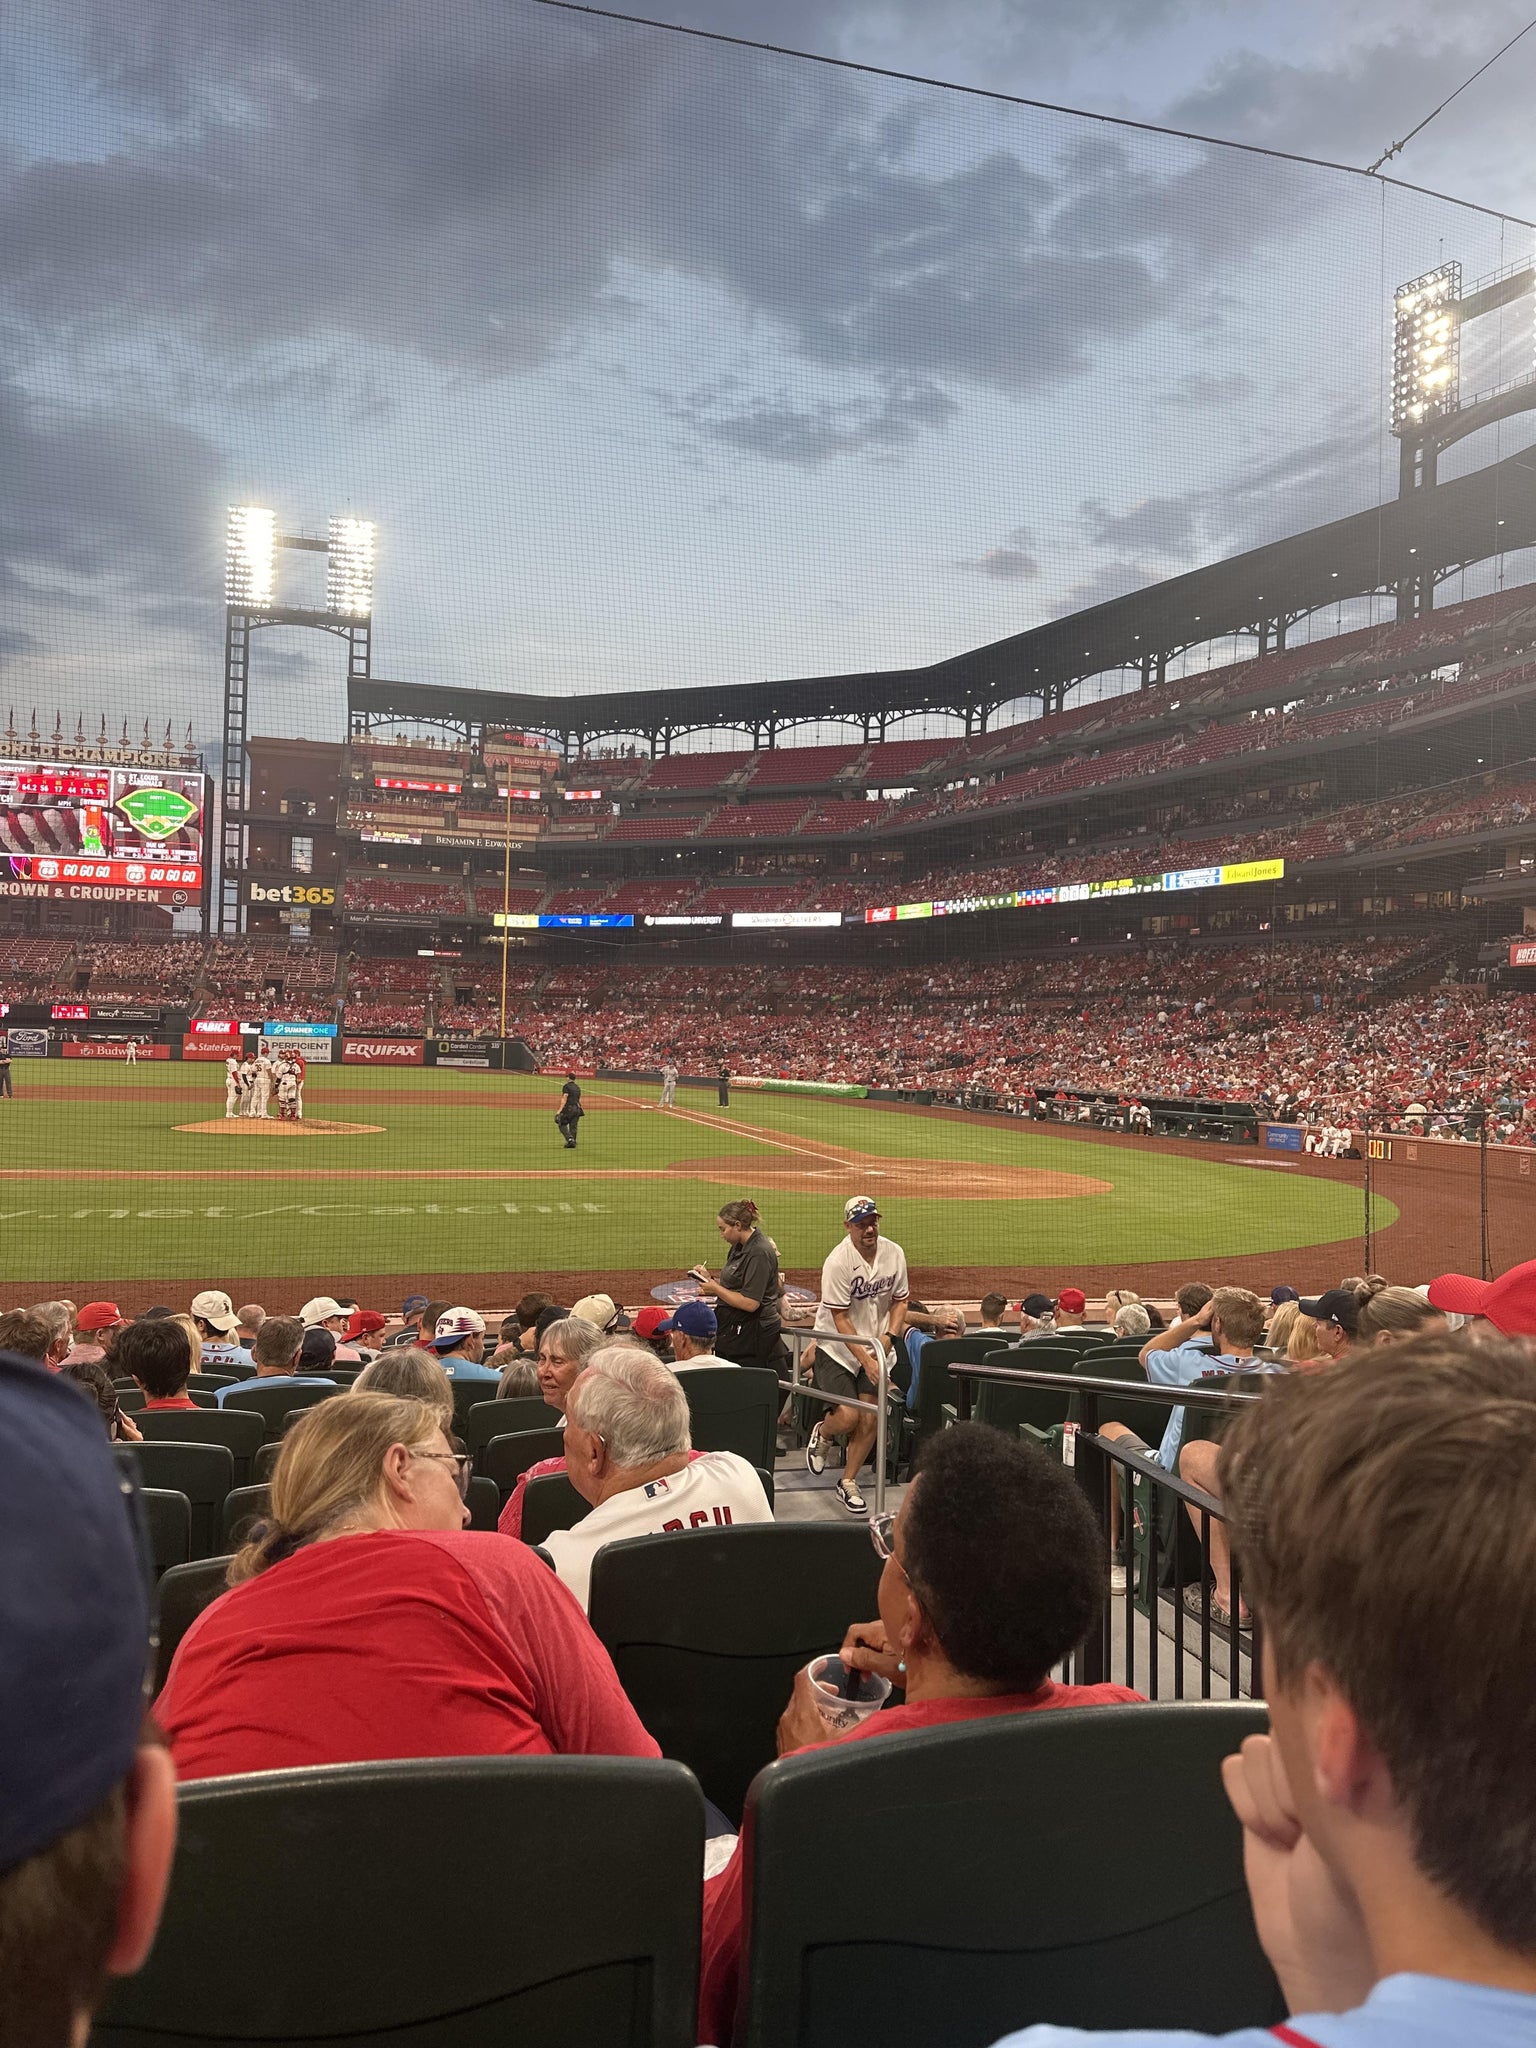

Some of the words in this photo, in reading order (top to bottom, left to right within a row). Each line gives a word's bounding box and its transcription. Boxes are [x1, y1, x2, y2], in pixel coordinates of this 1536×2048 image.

[59, 746, 180, 767] CHAMPIONS
[436, 836, 474, 846] BENJAMIN
[485, 839, 522, 849] EDWARDS
[63, 863, 78, 876] GO
[80, 865, 94, 877] GO
[96, 866, 110, 878] GO
[150, 869, 164, 881] GO
[166, 870, 180, 881] GO
[182, 871, 196, 882] GO
[54, 887, 65, 898] &
[69, 885, 159, 903] CROUPPEN
[250, 882, 335, 905] bet365
[279, 910, 310, 919] bet365
[97, 1010, 115, 1018] Mercy
[195, 1022, 232, 1033] FABICK
[15, 1031, 39, 1041] Ford
[97, 1046, 153, 1056] Budwser
[271, 1041, 330, 1050] PERFICIENT
[345, 1043, 417, 1058] EQUIFAX
